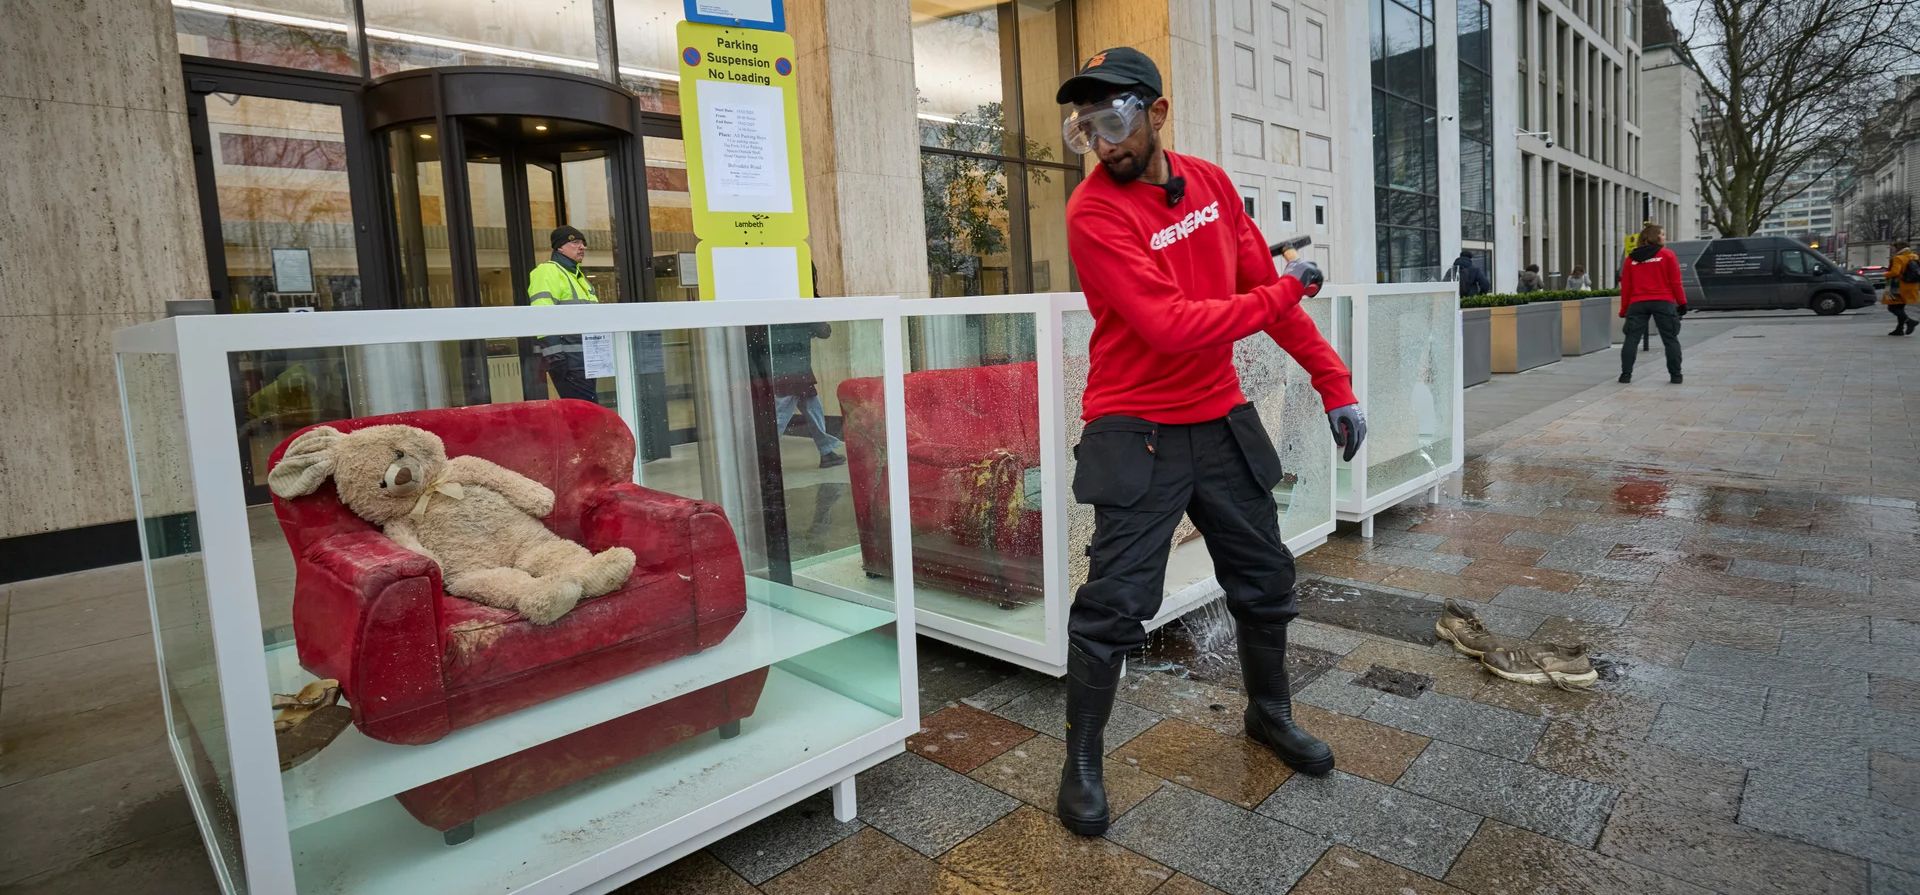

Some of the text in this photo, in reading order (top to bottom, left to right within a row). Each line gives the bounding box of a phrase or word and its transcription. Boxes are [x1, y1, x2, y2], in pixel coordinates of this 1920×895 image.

[717, 37, 758, 53] Parking
[707, 52, 770, 68] Suspension
[709, 68, 770, 86] No Loading
[735, 220, 764, 228] Lambeth
